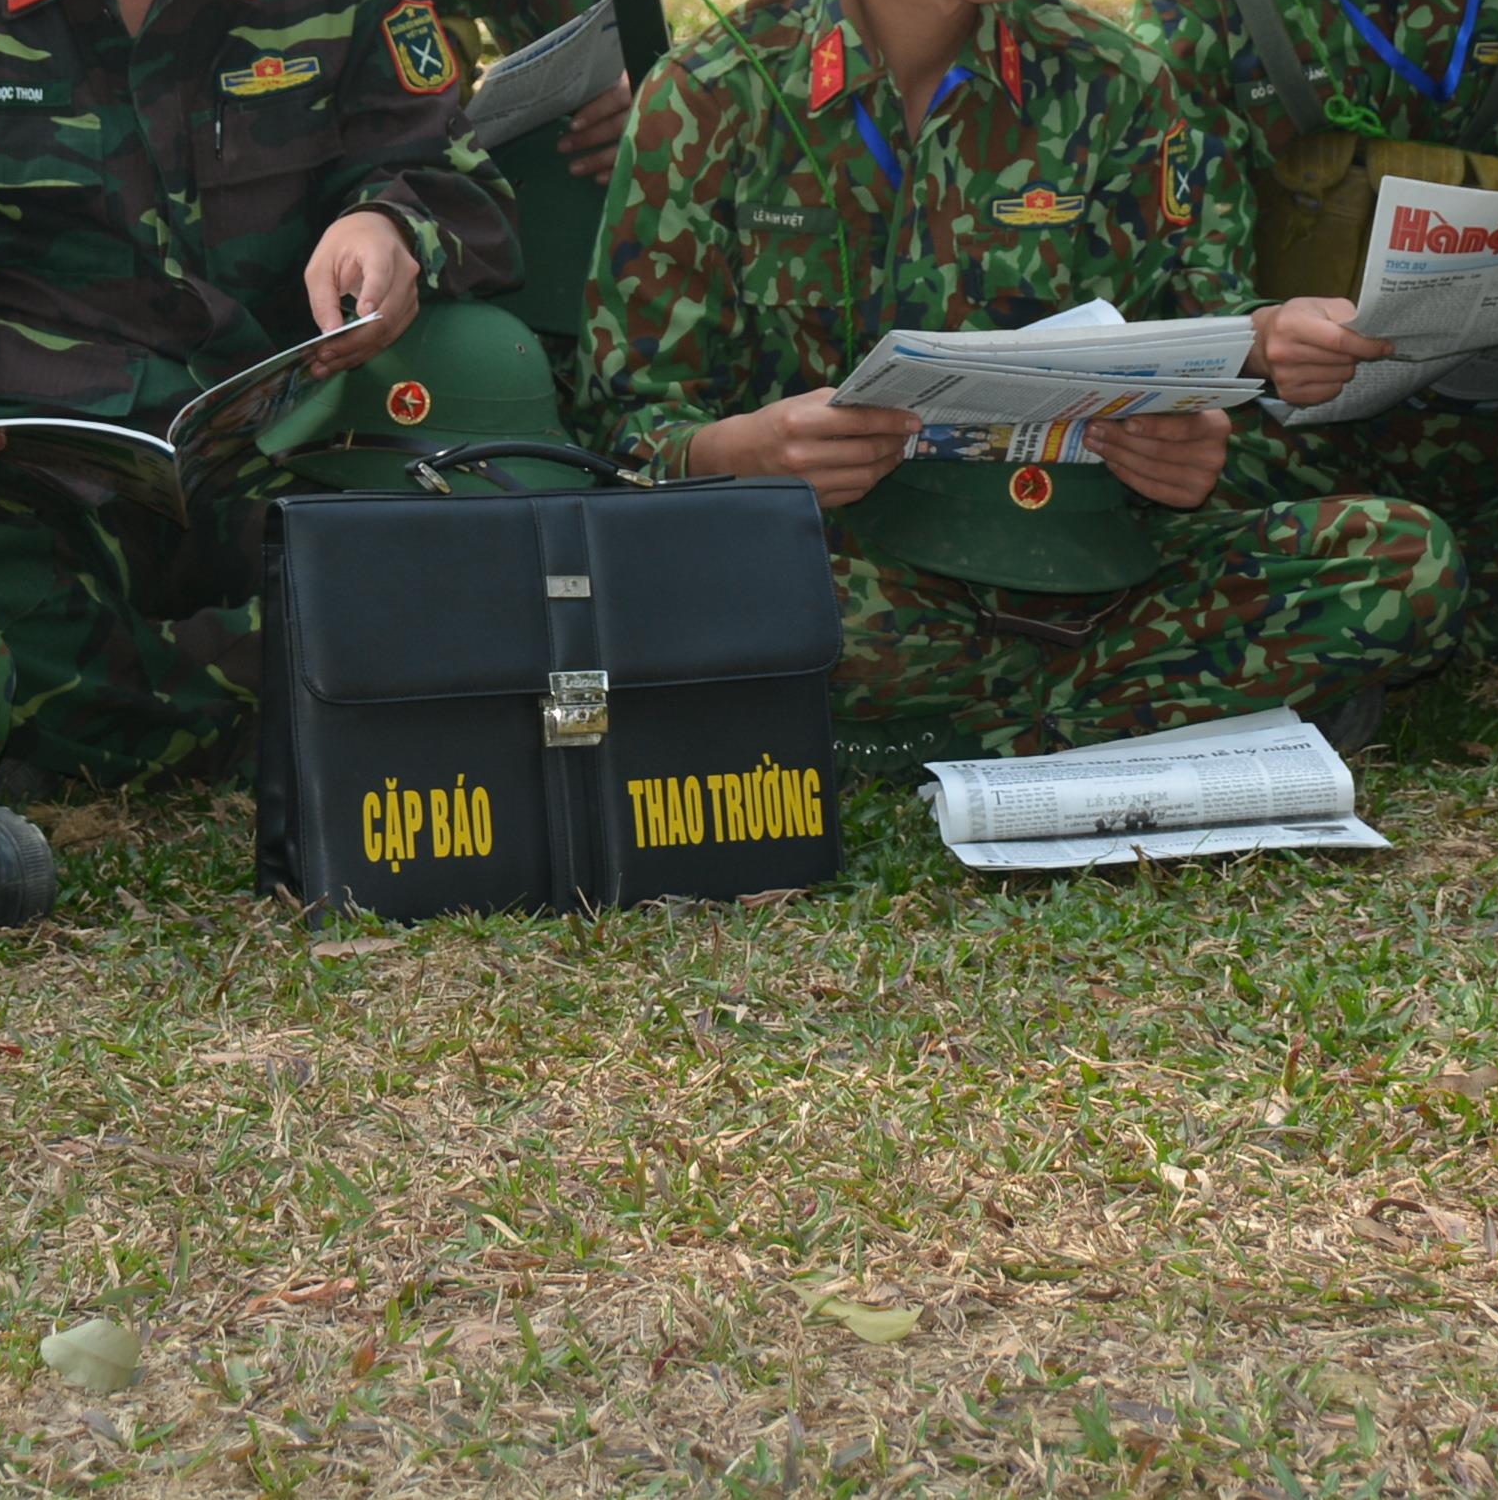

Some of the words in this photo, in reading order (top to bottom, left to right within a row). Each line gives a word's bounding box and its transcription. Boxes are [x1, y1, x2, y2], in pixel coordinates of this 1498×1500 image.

[362, 777, 423, 874] CẶP
[429, 773, 493, 858] BÁO
[628, 775, 704, 849] THAO
[707, 752, 824, 844] TRƯỜNG
